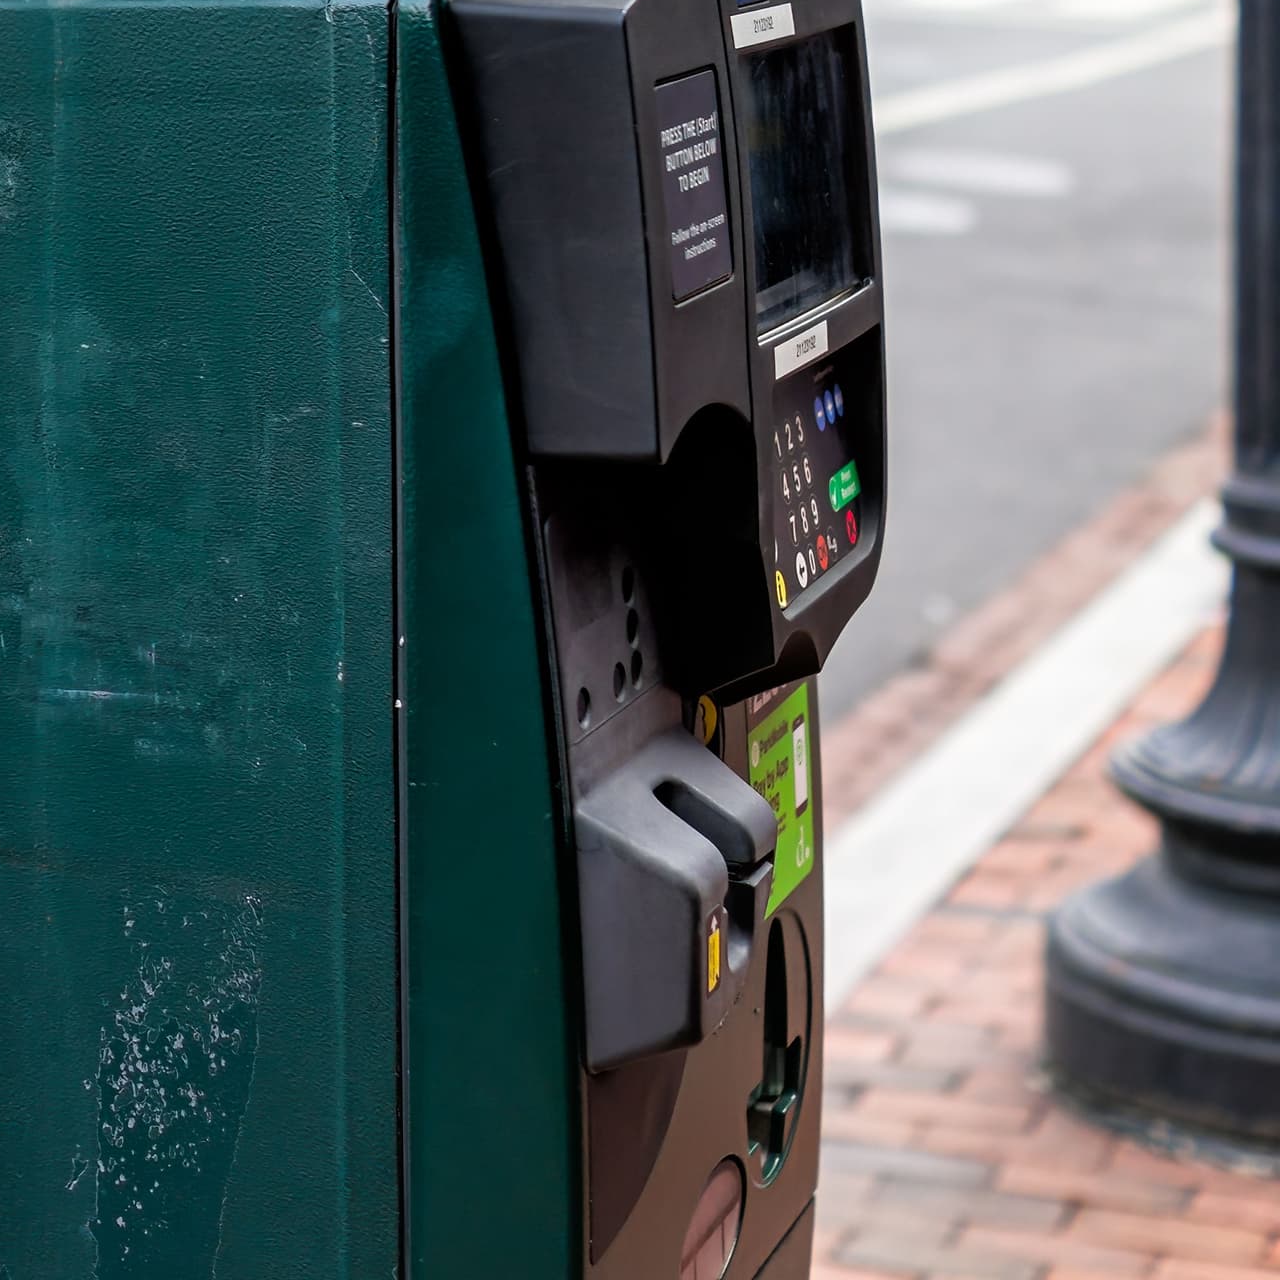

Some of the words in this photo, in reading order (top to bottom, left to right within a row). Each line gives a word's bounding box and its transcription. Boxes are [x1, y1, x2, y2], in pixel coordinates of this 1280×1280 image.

[661, 125, 683, 148] PRESS
[682, 120, 697, 140] THE
[666, 146, 694, 172] BUTTON
[694, 138, 717, 161] BELOW
[678, 175, 689, 193] TO
[689, 167, 710, 189] BEGIN
[672, 229, 690, 246] Follow
[690, 223, 700, 237] the
[684, 238, 716, 260] instructions
[775, 431, 782, 458] 1
[785, 423, 794, 450] 2
[796, 415, 804, 442] 3
[783, 472, 790, 500] 4
[793, 465, 801, 492] 5
[804, 457, 812, 484] 6
[789, 515, 797, 542] 7
[801, 506, 809, 534] 8
[811, 498, 819, 526] 9
[808, 548, 816, 575] 0
